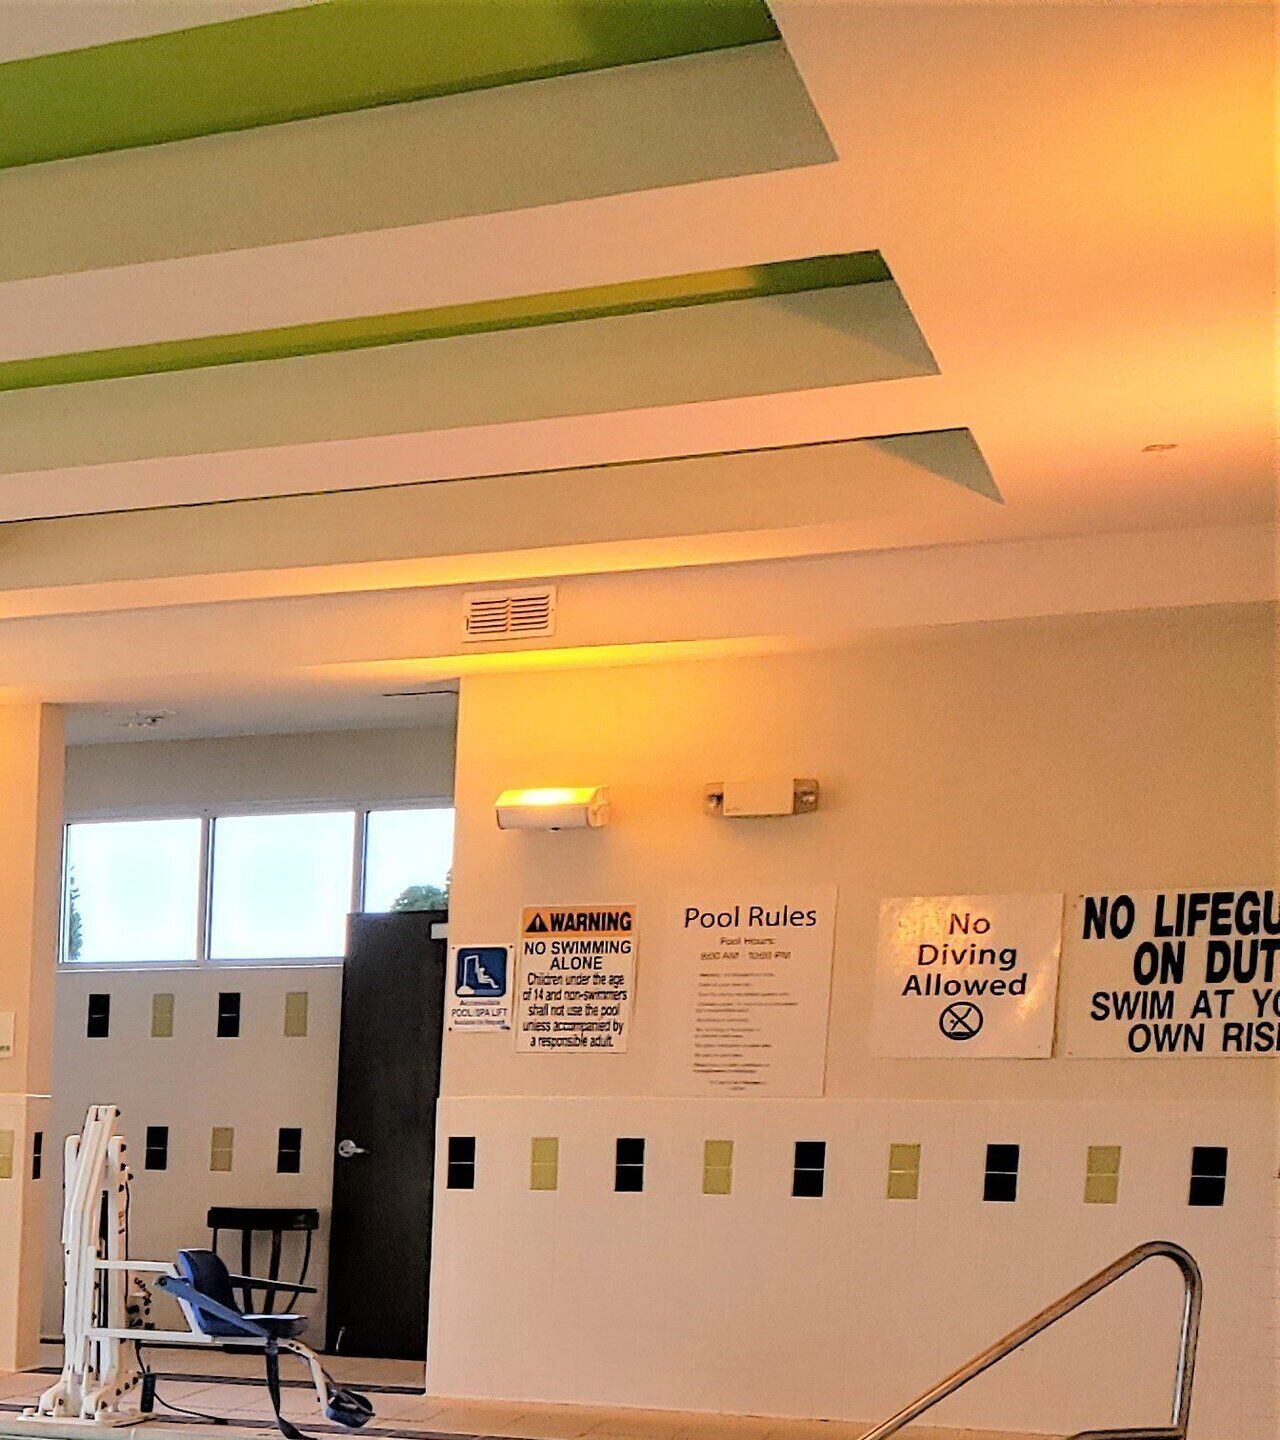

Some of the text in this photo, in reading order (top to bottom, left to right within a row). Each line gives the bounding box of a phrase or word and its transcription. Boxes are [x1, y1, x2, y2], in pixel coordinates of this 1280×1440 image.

[550, 911, 632, 932] WARNING
[684, 904, 817, 929] Pool Rules
[948, 913, 991, 935] No
[1082, 894, 1135, 940] NO
[524, 940, 632, 955] NO SWIMMING
[918, 943, 1018, 971] Diving
[550, 956, 603, 970] ALONE
[1133, 940, 1186, 985] ON
[527, 972, 625, 989] Children under the age
[901, 973, 1028, 997] Allowed
[523, 988, 628, 1001] of 14 and non-swimmers
[1090, 990, 1174, 1021] SWIM
[1190, 989, 1235, 1019] AT
[528, 1003, 621, 1018] shall not use the pool
[522, 1019, 624, 1035] unless accompanied by
[530, 1036, 536, 1047] a
[538, 1033, 588, 1049] responsible
[1128, 1022, 1280, 1054] OWN RIS
